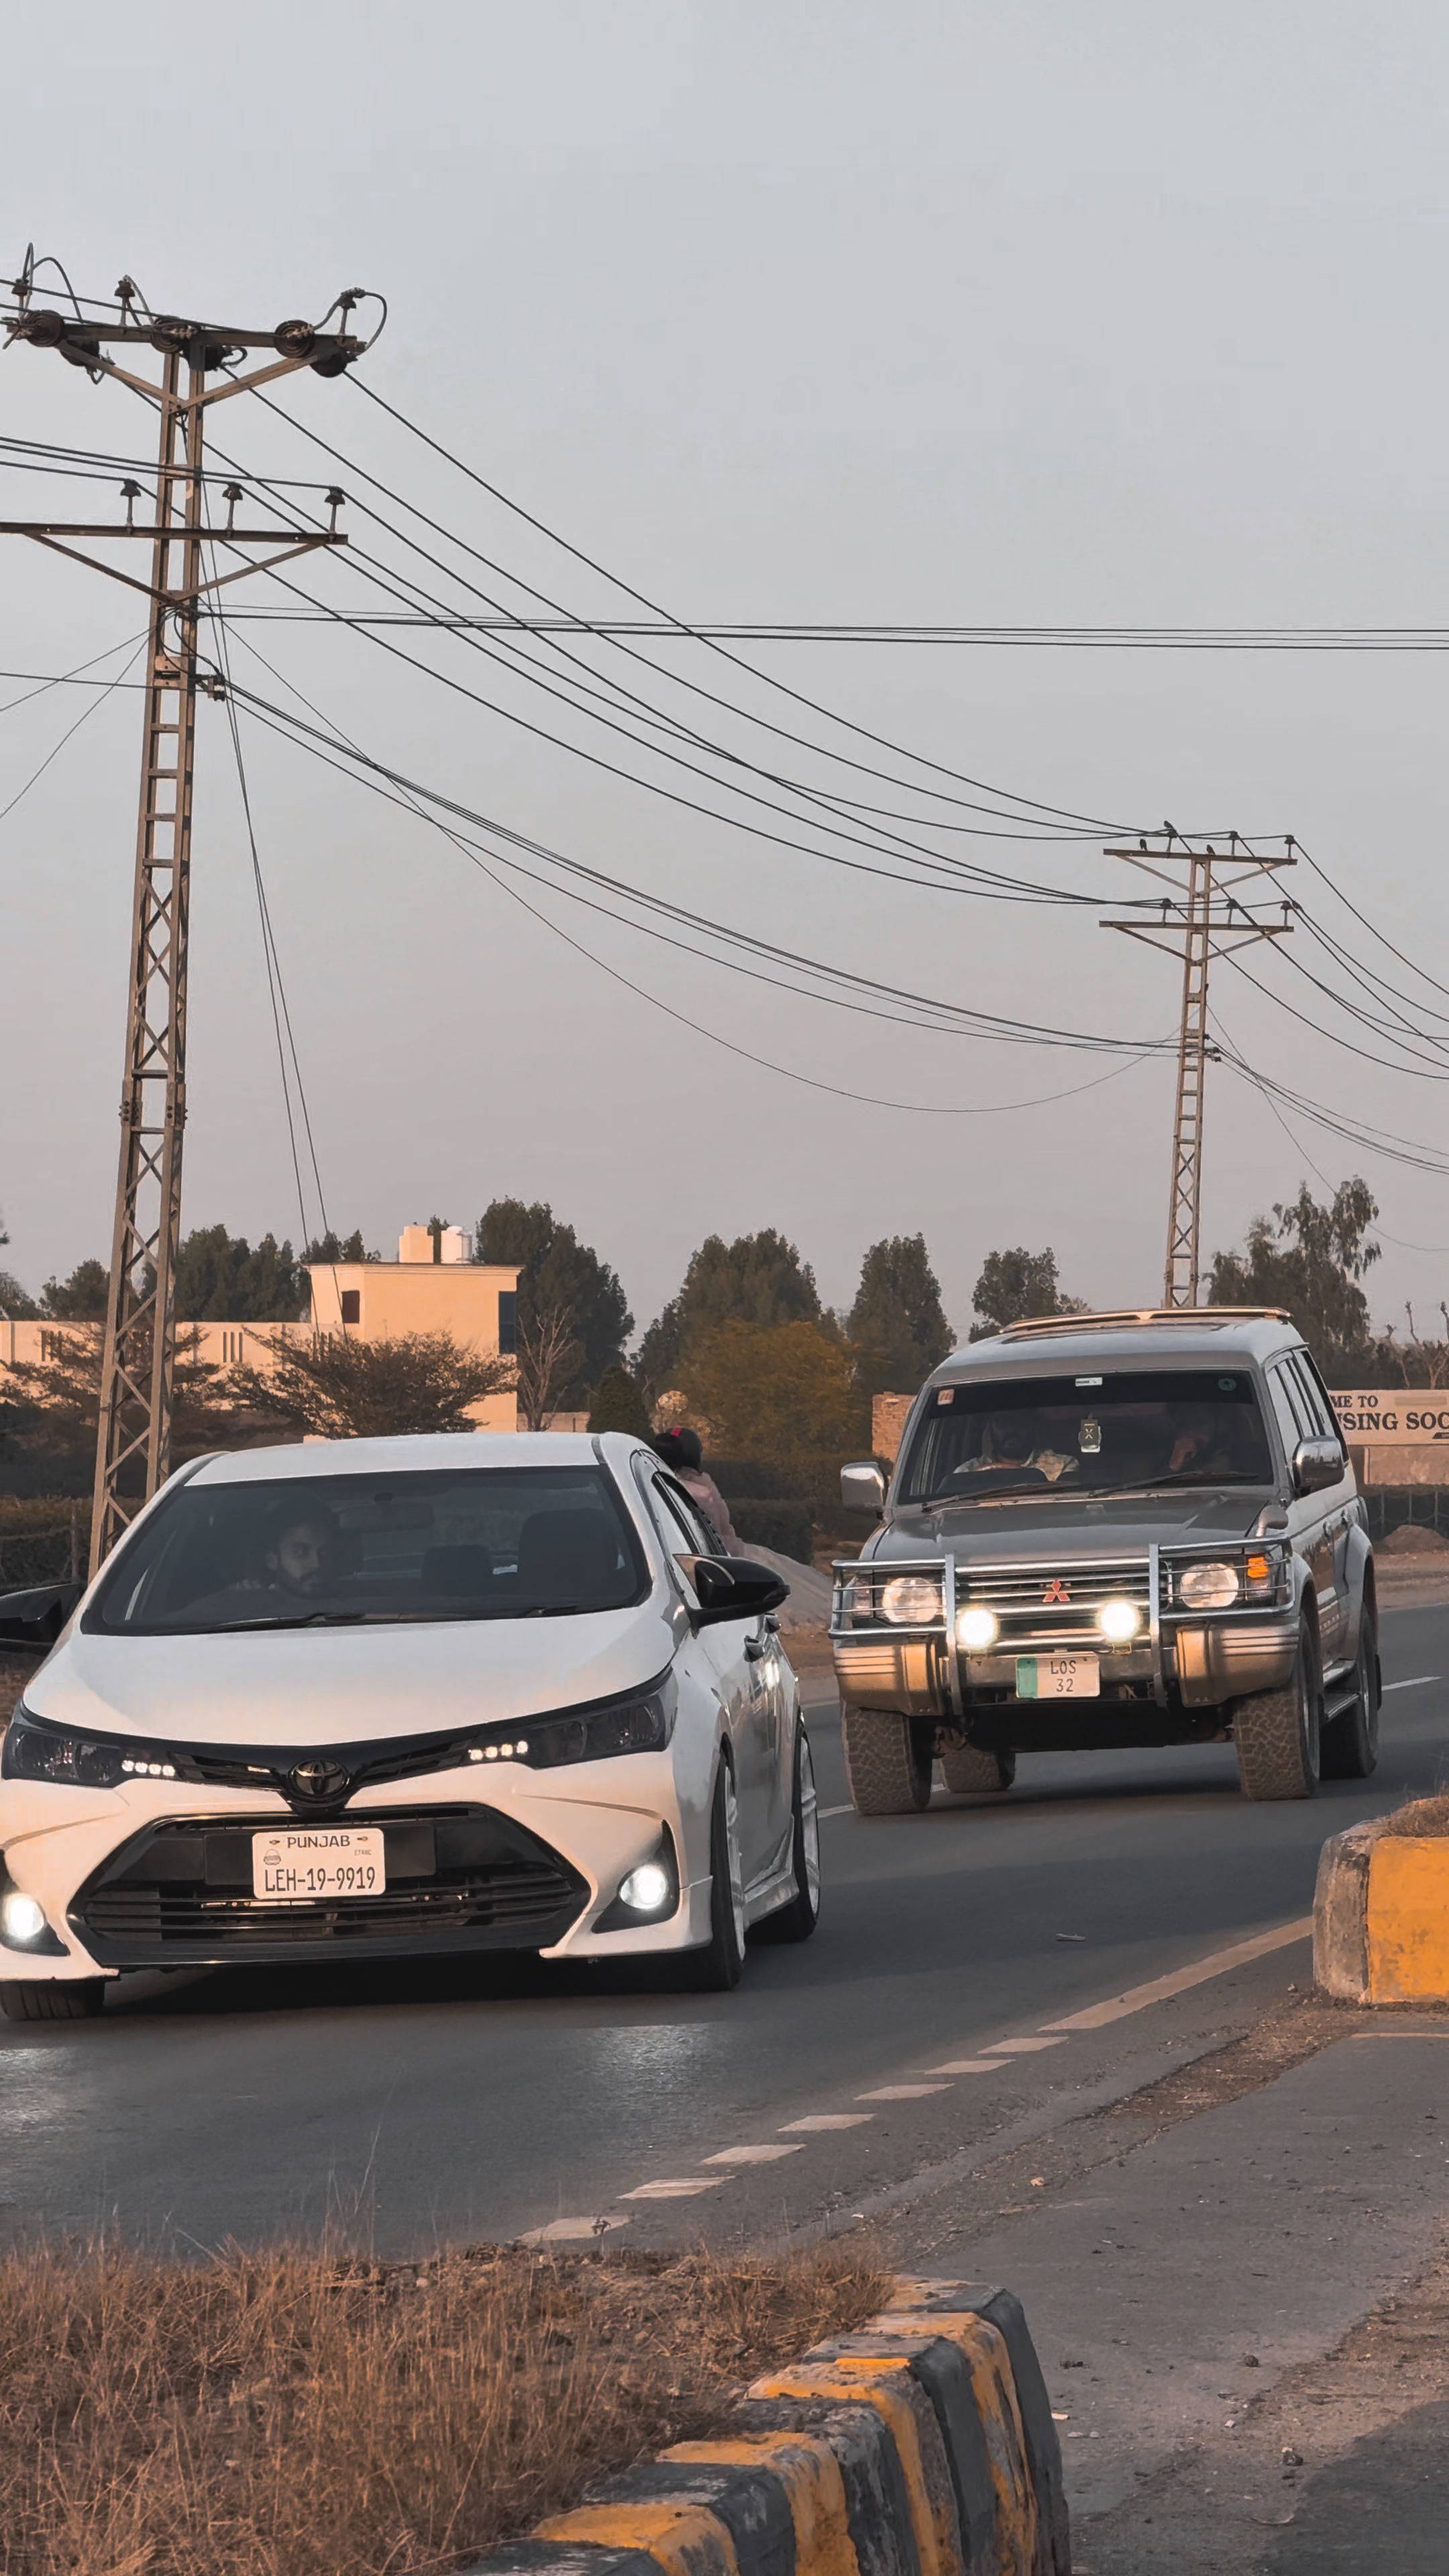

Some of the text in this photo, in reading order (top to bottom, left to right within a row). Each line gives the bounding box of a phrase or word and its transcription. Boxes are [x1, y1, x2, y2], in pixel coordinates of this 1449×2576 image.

[1358, 1395, 1379, 1407] TO
[1051, 1660, 1076, 1674] LOS
[1057, 1678, 1073, 1692] 32
[287, 1835, 350, 1848] PUNJAB
[265, 1866, 375, 1892] LEH-19-9919
